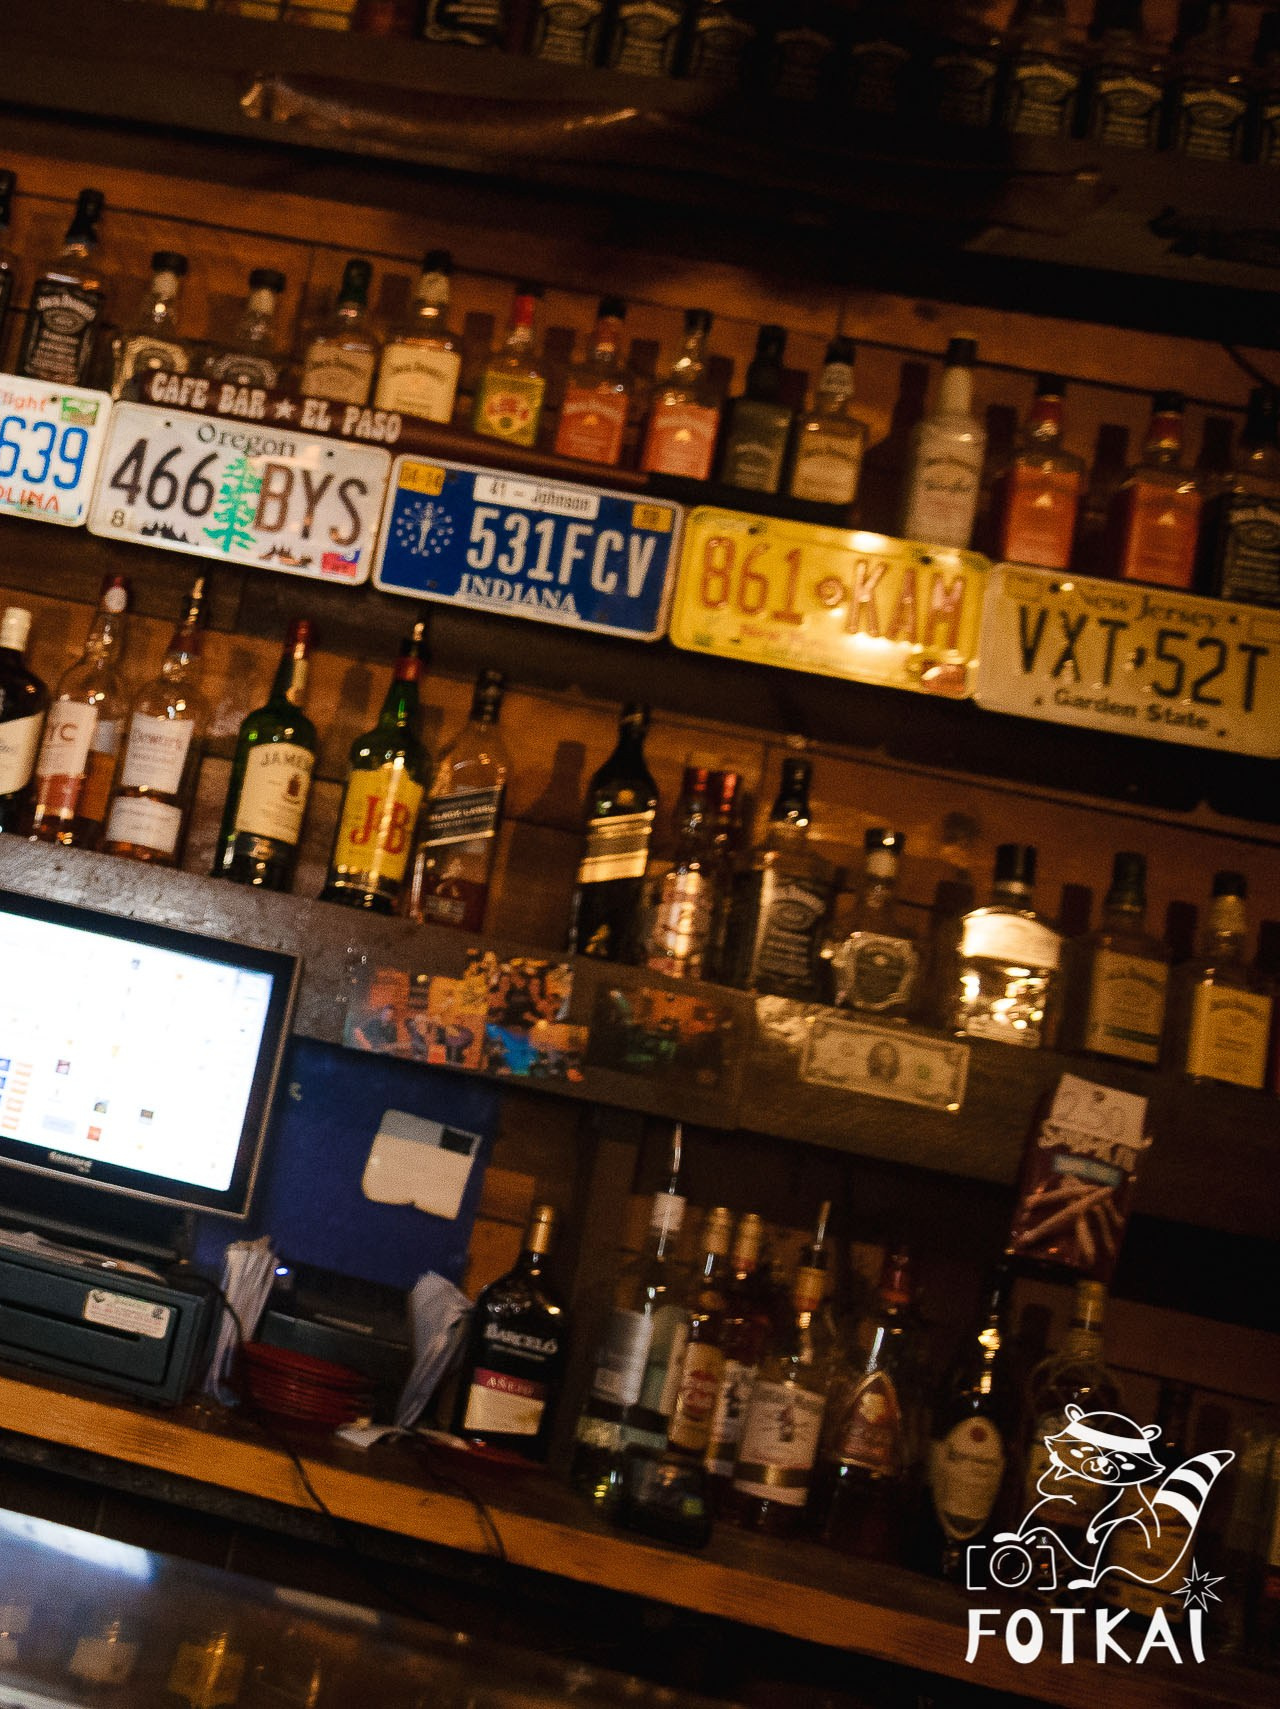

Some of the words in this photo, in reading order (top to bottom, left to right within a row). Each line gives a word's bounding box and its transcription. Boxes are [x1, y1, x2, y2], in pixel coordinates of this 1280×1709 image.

[218, 385, 267, 420] BAR
[300, 398, 333, 432] EL
[342, 405, 403, 443] PASO
[197, 422, 298, 458] Oregon
[110, 438, 219, 517] 466
[252, 462, 369, 546] BYS
[466, 505, 657, 599] 531FCV
[459, 573, 578, 615] INDIANA
[699, 535, 803, 625] 861
[1132, 594, 1219, 629] Jersey
[1053, 687, 1138, 719] Garden
[1147, 703, 1210, 730] State
